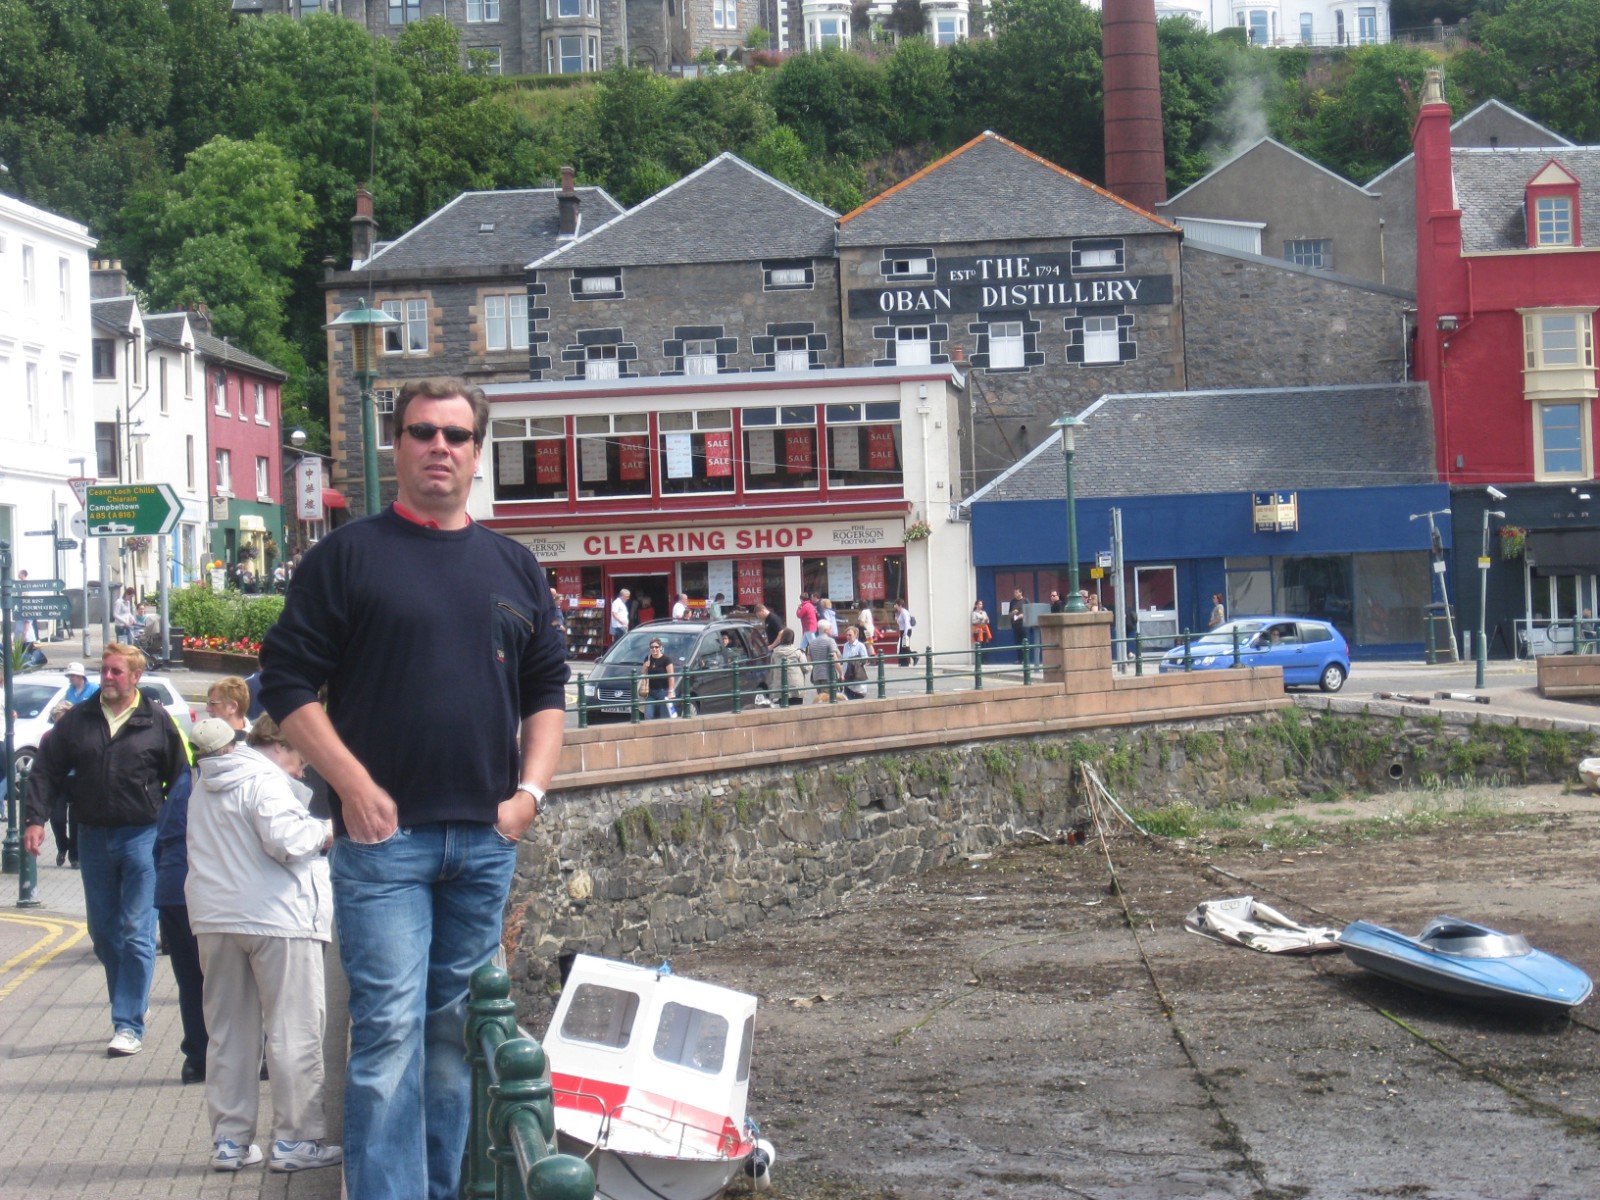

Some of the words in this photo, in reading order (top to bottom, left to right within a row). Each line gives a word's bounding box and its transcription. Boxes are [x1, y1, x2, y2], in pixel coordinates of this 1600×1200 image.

[976, 257, 1030, 279] THE
[1035, 265, 1060, 277] 1794
[879, 288, 951, 312] OBAN
[982, 279, 1143, 308] DISTILLERY
[787, 436, 810, 444] SALE
[870, 432, 893, 441] SALE
[621, 443, 642, 451] SALE
[707, 439, 729, 448] SALE
[537, 447, 559, 455] SALE
[871, 450, 893, 459] SALE
[708, 458, 730, 466] SALE
[788, 454, 811, 462] SALE
[622, 461, 643, 469] SALE
[89, 488, 112, 496] Ceann
[114, 487, 131, 495] Loch
[133, 486, 155, 494] Chille
[89, 503, 140, 512] Campbeltown
[832, 530, 885, 540] ROGERSON
[583, 531, 725, 555] CLEARING
[735, 527, 813, 550] SHOP
[527, 543, 566, 552] GERSON
[861, 563, 882, 572] SALE
[739, 569, 761, 577] SALE
[861, 581, 883, 590] SALE
[740, 586, 762, 595] SALE
